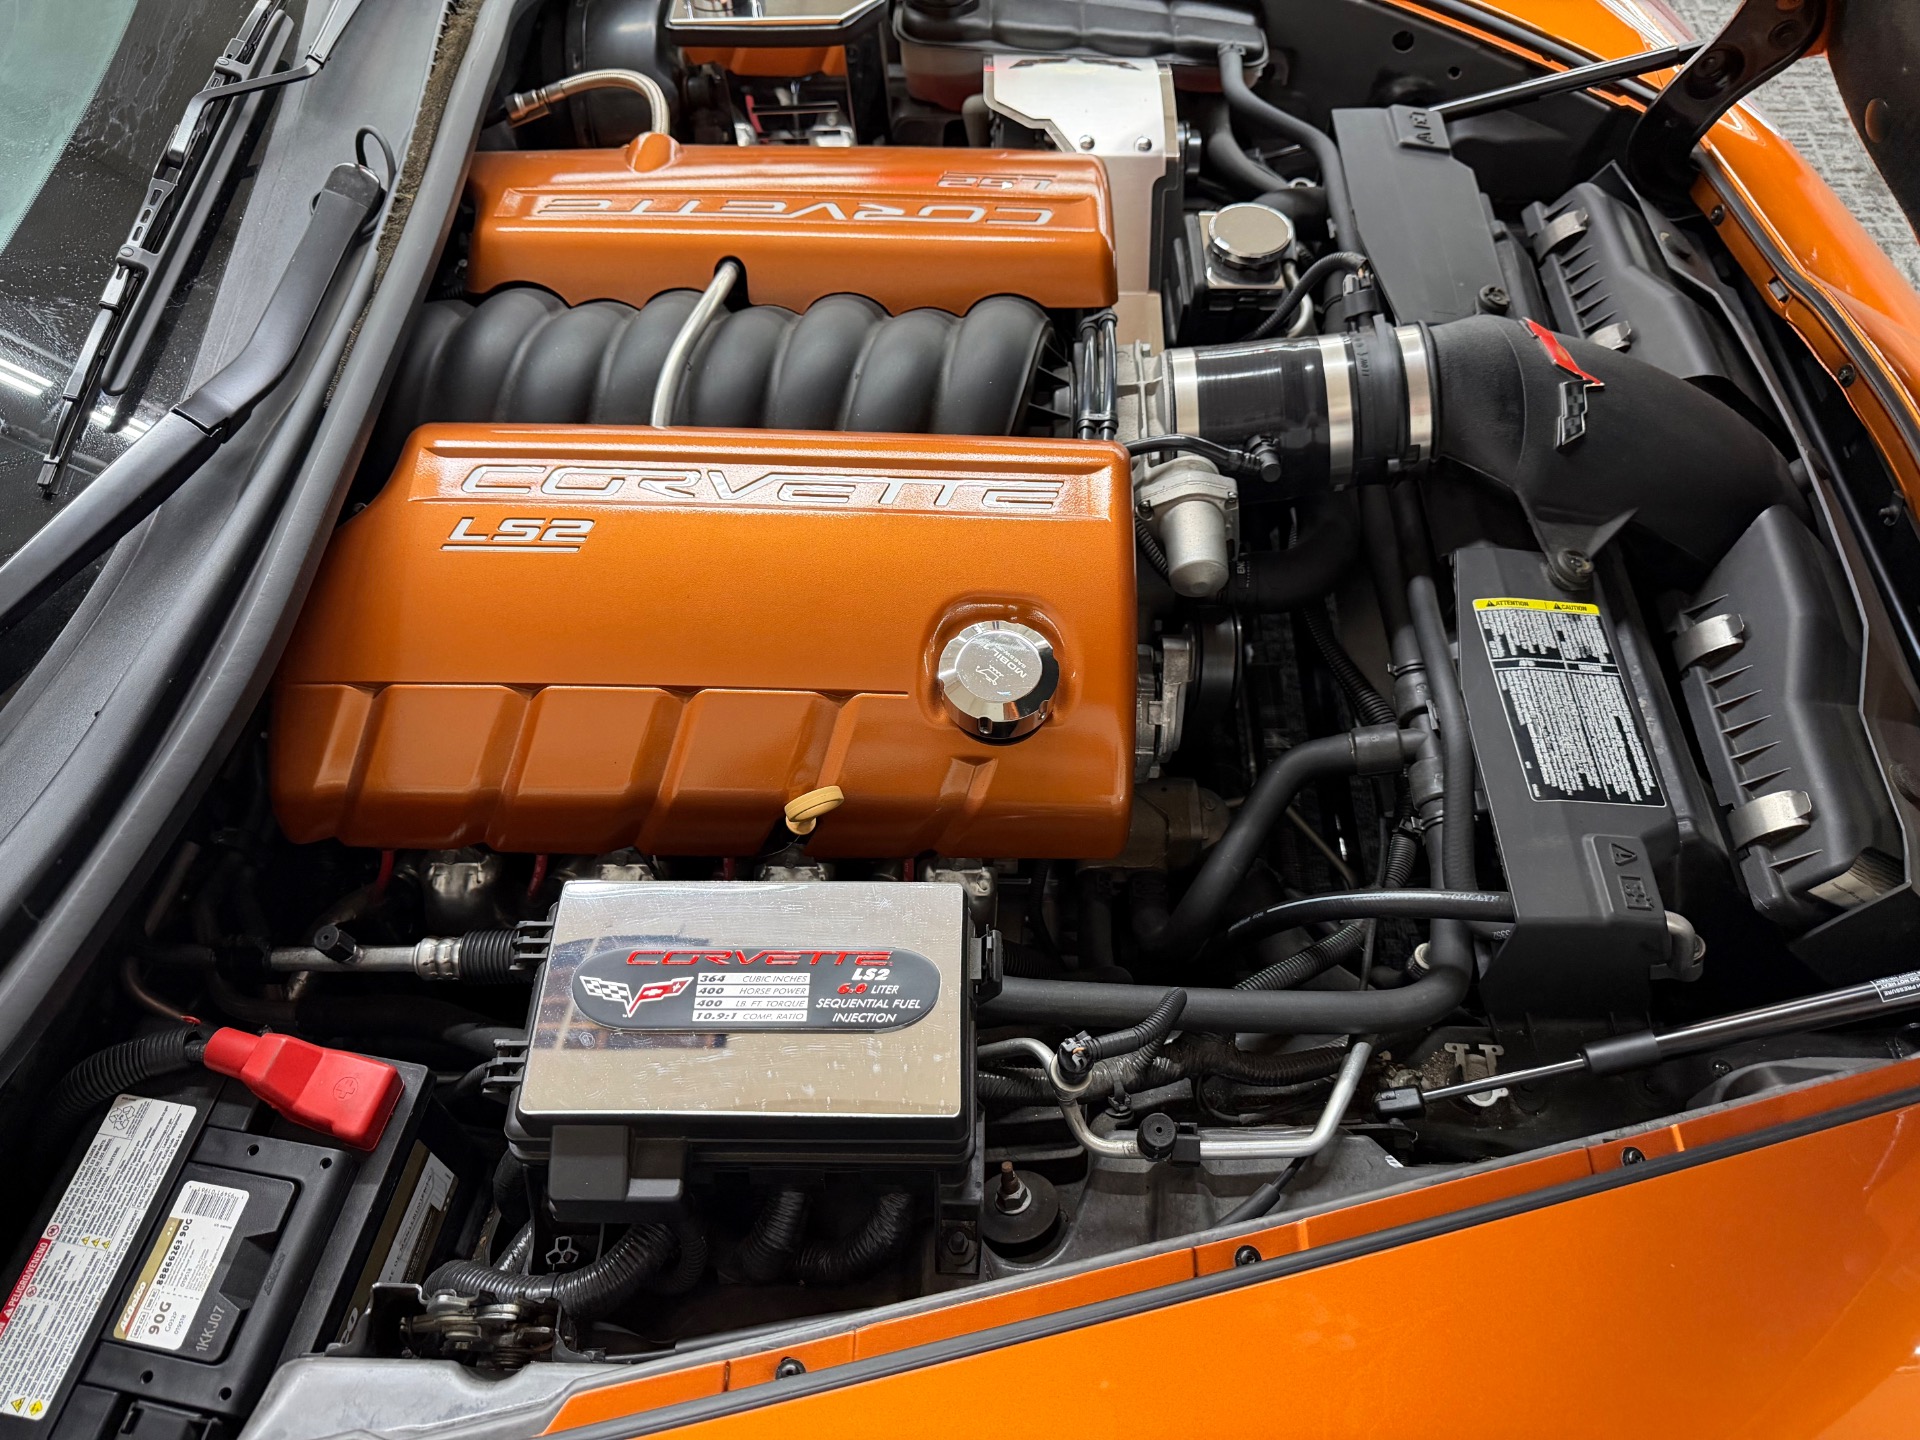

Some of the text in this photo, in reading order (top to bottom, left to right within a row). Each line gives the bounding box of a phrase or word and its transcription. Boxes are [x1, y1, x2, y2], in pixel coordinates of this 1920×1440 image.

[937, 171, 1056, 190] LS2
[535, 198, 1054, 226] CORVETTE
[461, 464, 1066, 510] CORVETTE
[447, 516, 597, 542] LS2
[992, 649, 1027, 678] MOBIL
[625, 950, 893, 966] CORVETTE
[852, 968, 890, 980] LS2
[837, 983, 899, 994] 6.0 LITER
[816, 999, 920, 1008] SEQUENTIAL FUEL
[833, 1013, 897, 1022] INJECTION
[155, 1238, 183, 1285] 88866263
[178, 1217, 193, 1237] 90G
[7, 1241, 48, 1307] PELIGRO/VENENO
[119, 1281, 146, 1332] ACDelco
[146, 1300, 172, 1335] 90G
[195, 1305, 225, 1351] 1KKJ07
